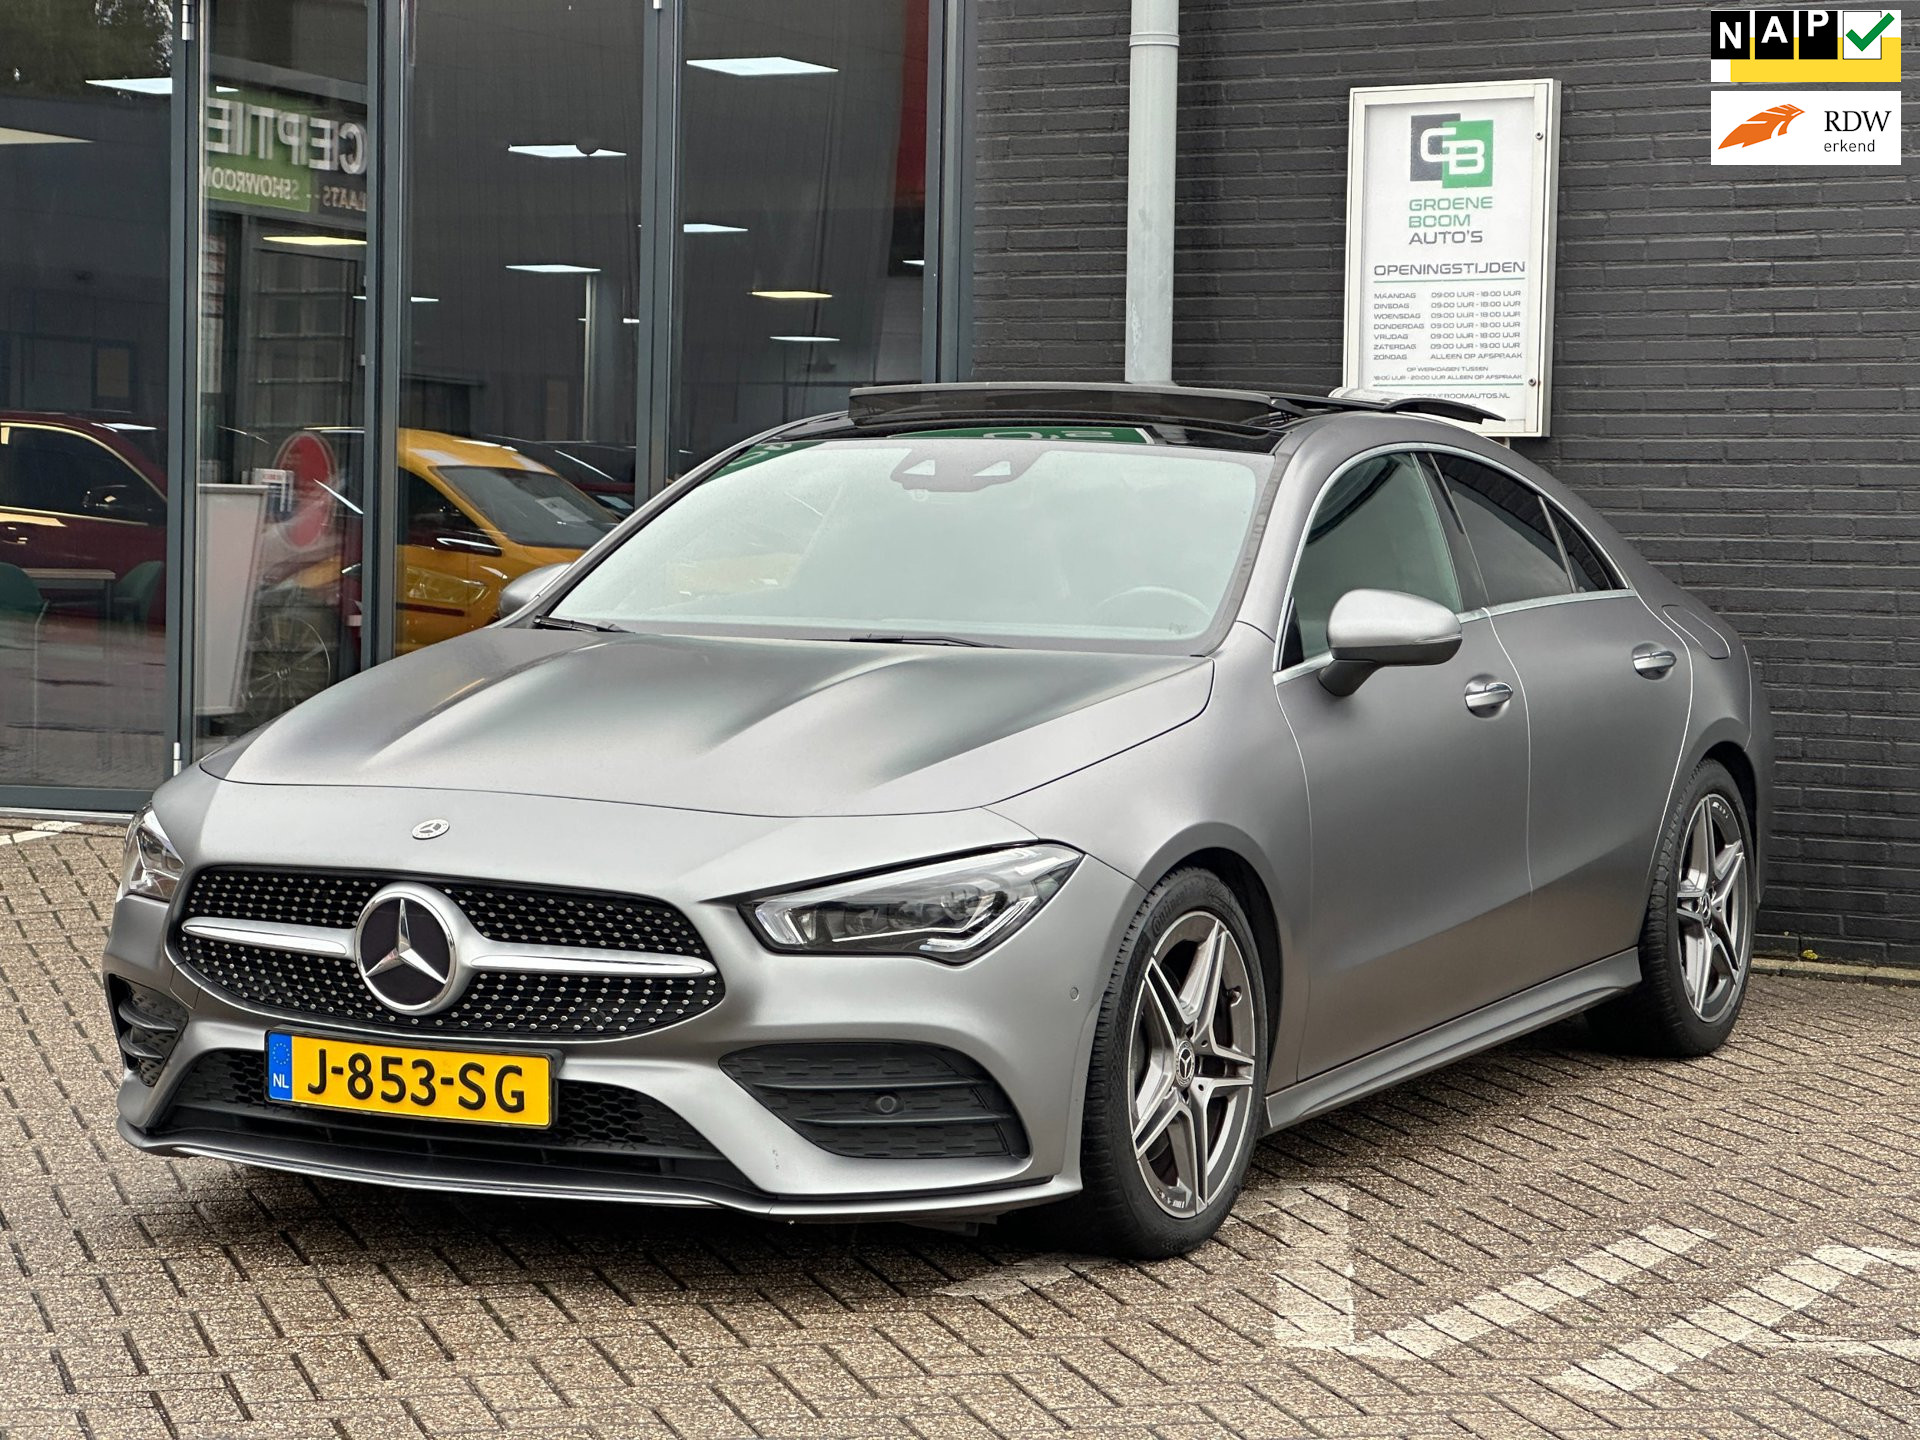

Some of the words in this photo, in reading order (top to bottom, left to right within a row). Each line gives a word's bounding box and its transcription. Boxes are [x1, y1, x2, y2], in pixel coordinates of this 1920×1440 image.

[1409, 196, 1493, 212] GROENE
[1408, 214, 1471, 228] BOOM
[1408, 230, 1483, 245] AUTO'S
[1374, 261, 1525, 276] OPENINGSTIJDEN
[272, 1073, 289, 1089] NL
[307, 1048, 525, 1113] J-853-SG
